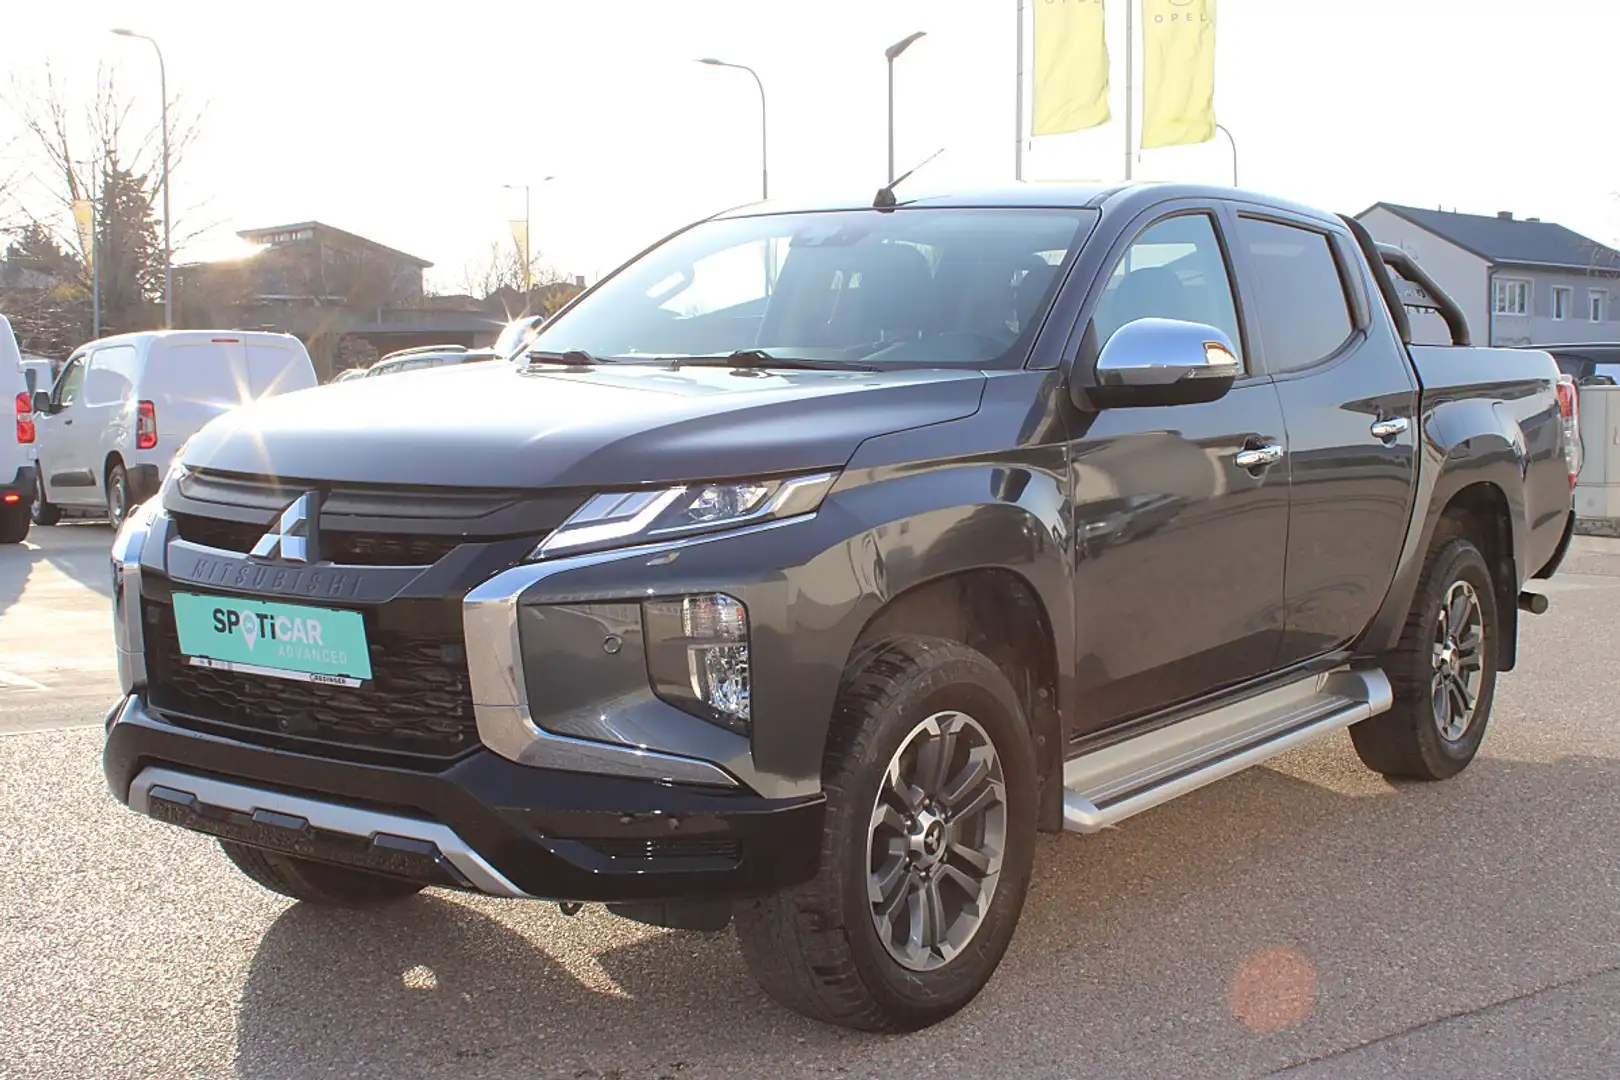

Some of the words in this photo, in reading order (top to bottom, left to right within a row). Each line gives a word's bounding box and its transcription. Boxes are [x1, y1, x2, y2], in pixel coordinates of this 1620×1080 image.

[1154, 13, 1207, 23] OPEL
[192, 559, 363, 596] MITSUBISHI
[277, 645, 348, 665] ADVANCED
